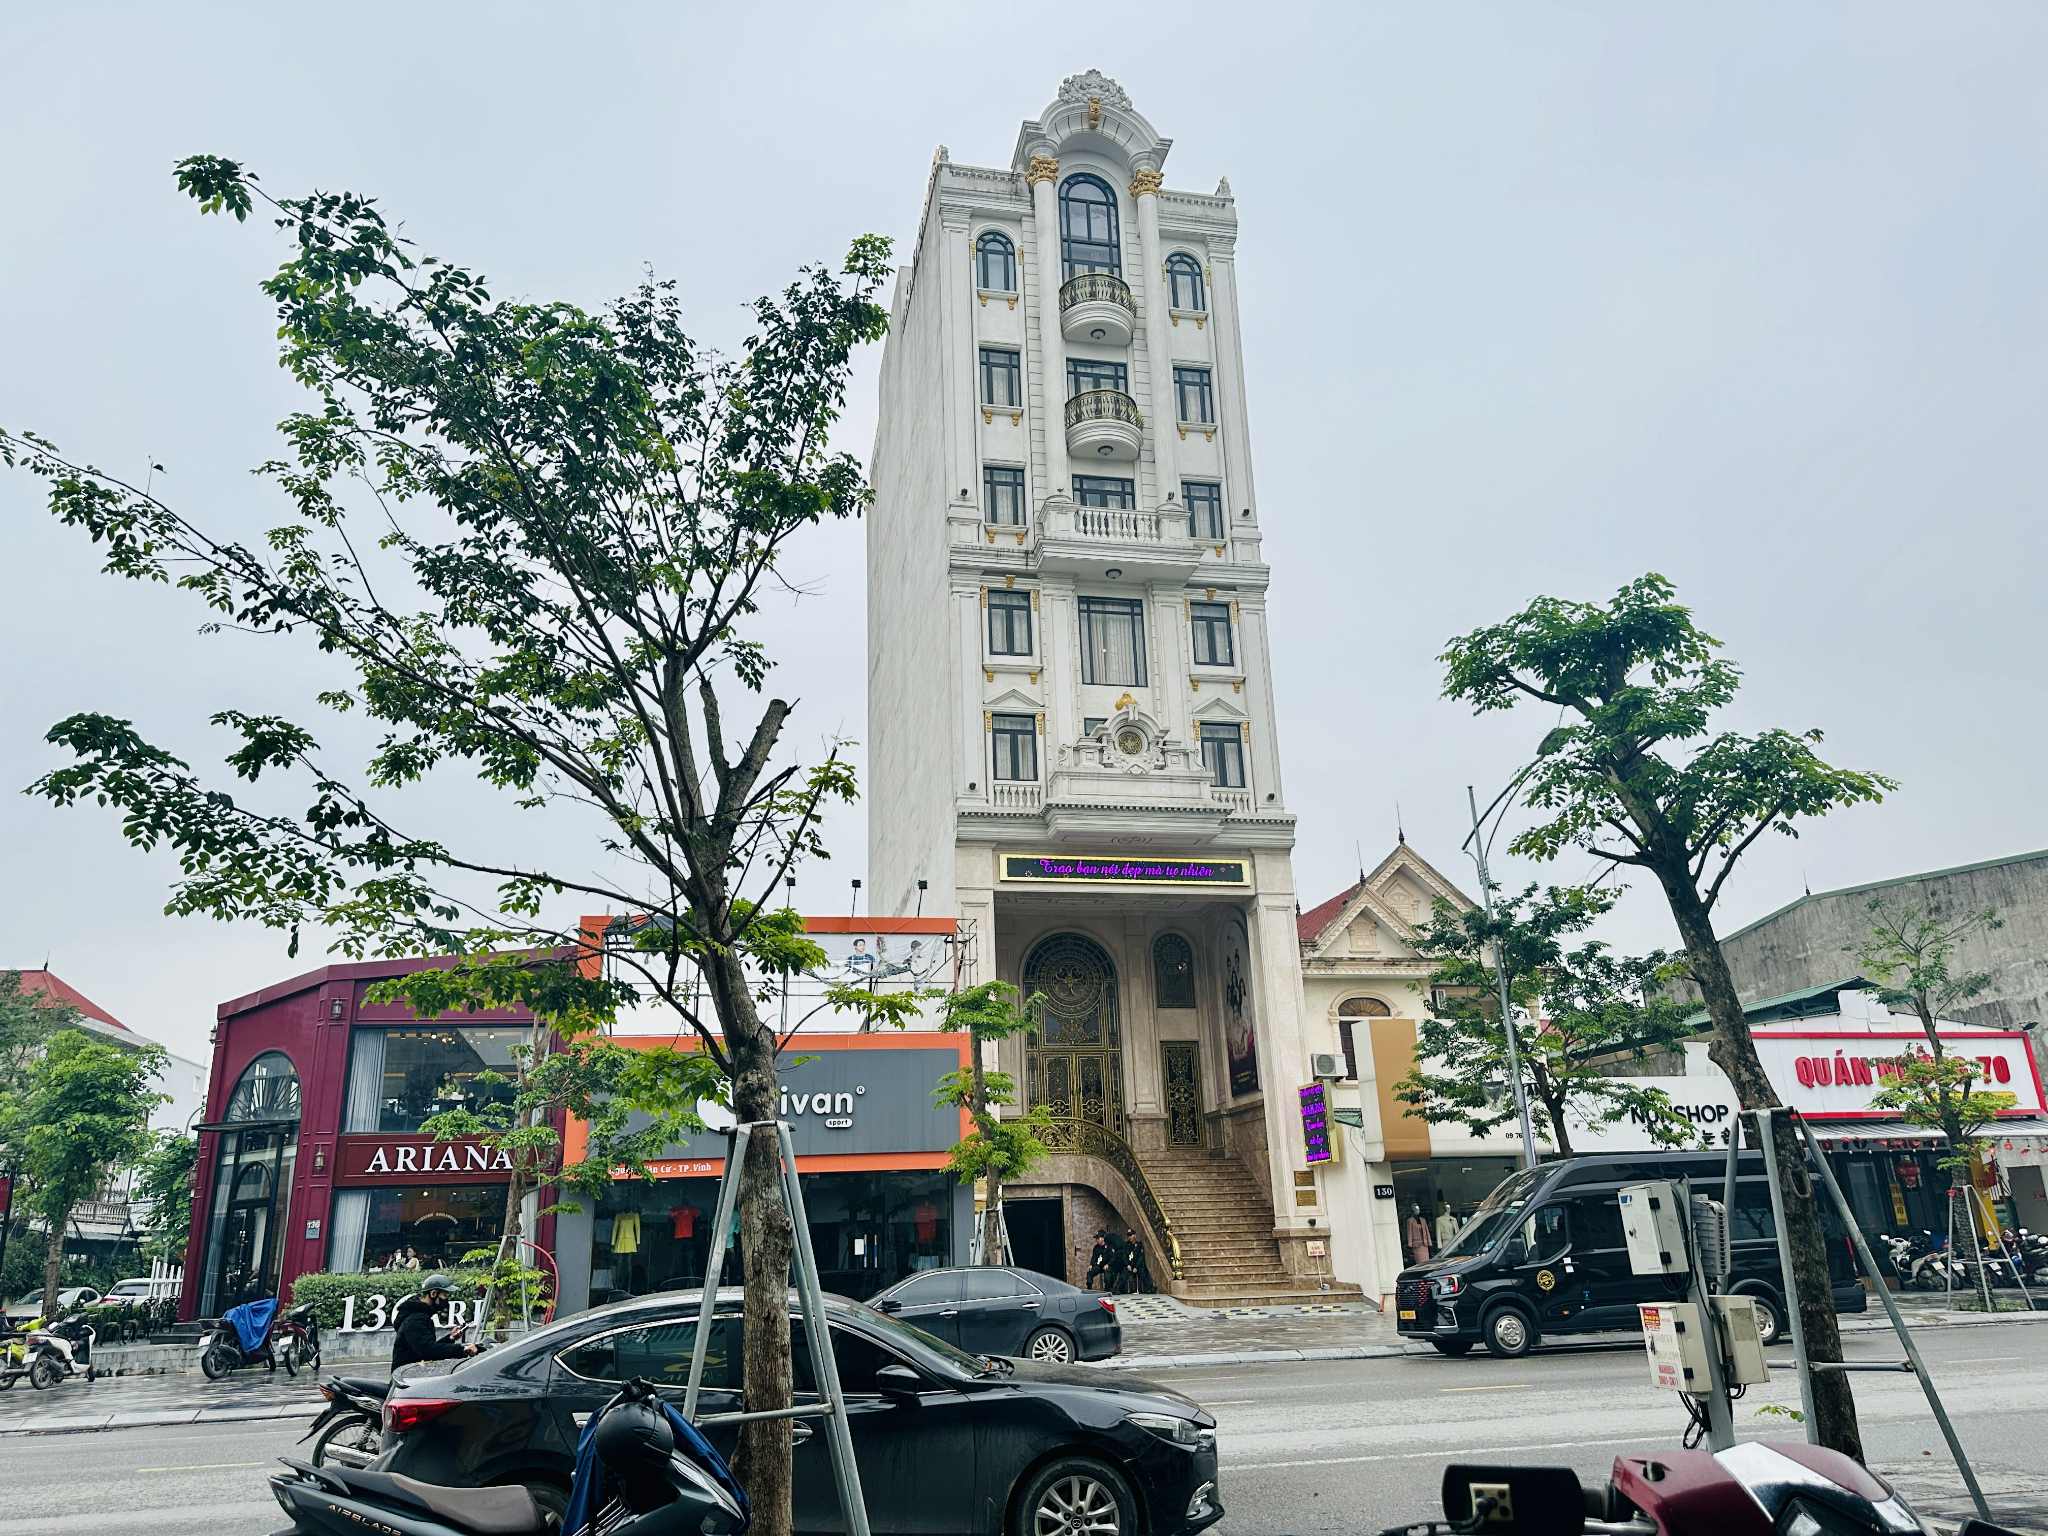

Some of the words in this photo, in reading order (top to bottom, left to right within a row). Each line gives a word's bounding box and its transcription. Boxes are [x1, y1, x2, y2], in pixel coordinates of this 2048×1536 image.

[1040, 859, 1074, 874] Trao
[1795, 1049, 1873, 1088] QUÁN
[779, 1085, 854, 1115] ivan
[828, 1119, 849, 1127] sport
[365, 1145, 513, 1172] ARIANA
[1376, 1188, 1392, 1196] 130
